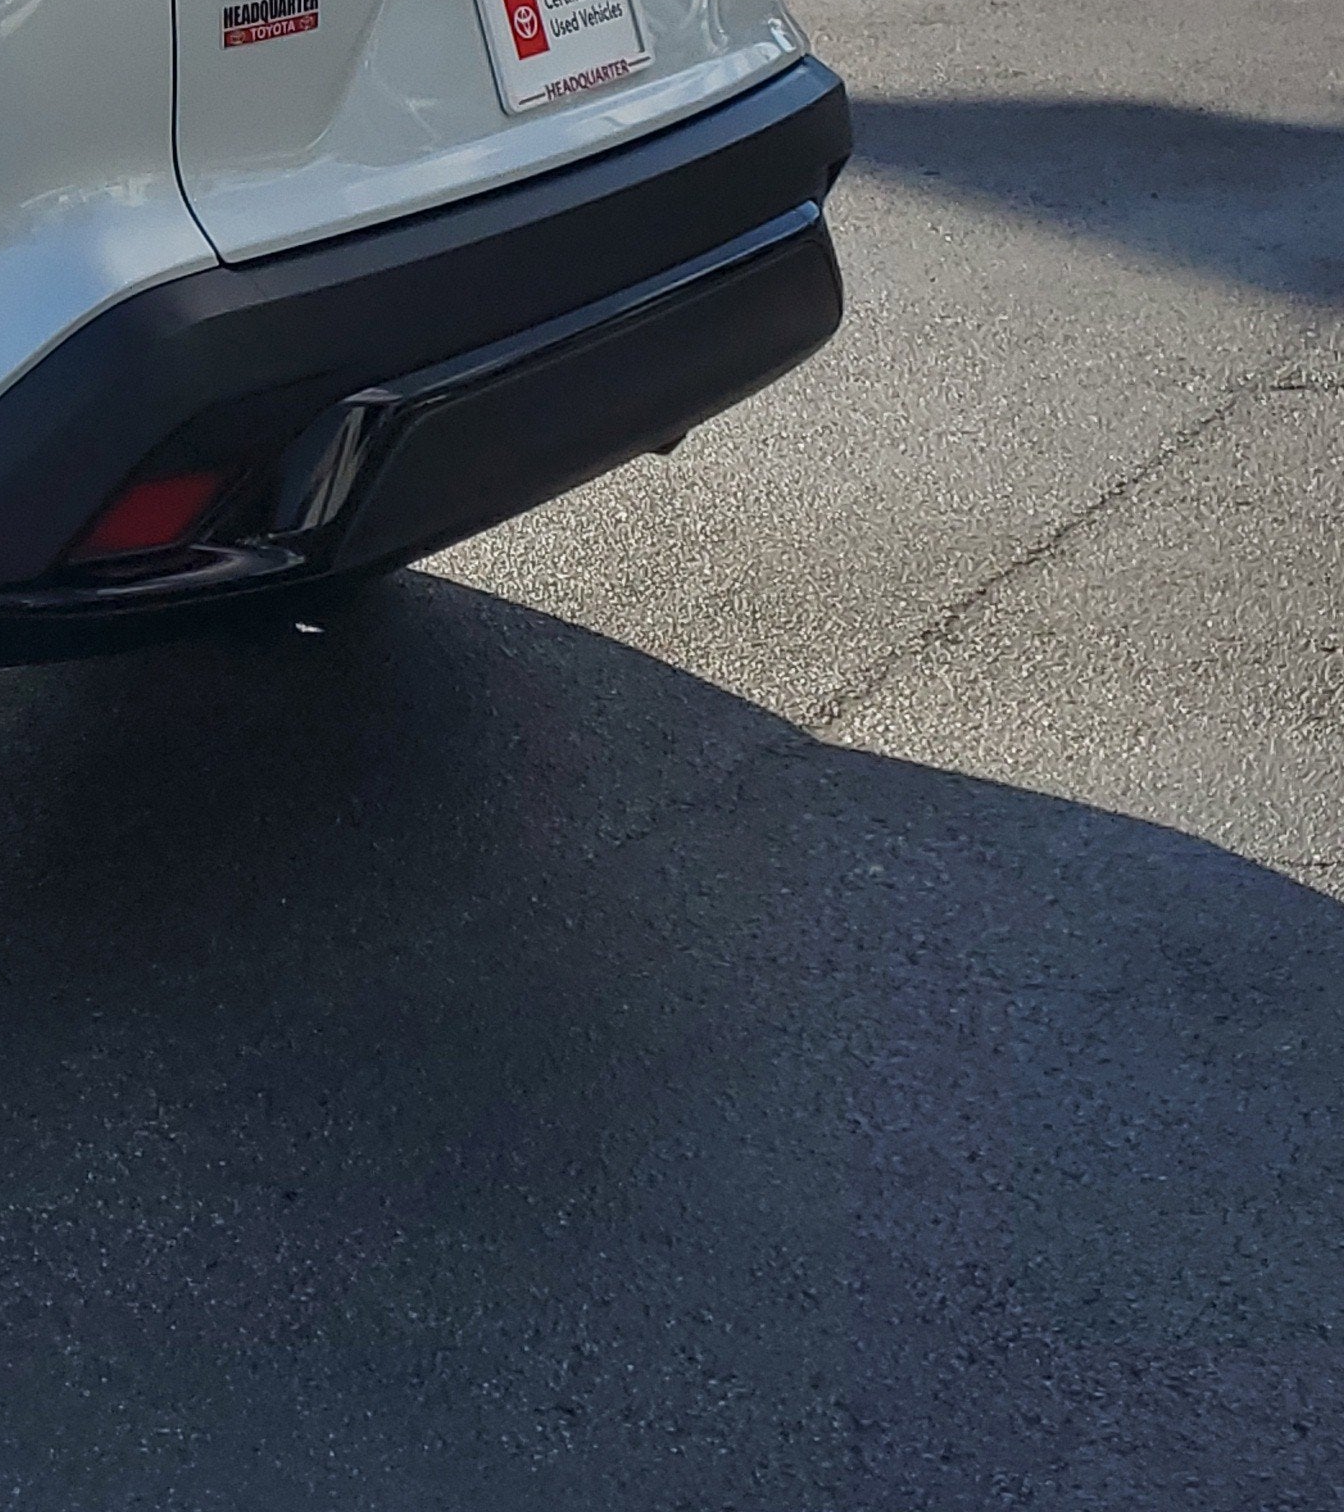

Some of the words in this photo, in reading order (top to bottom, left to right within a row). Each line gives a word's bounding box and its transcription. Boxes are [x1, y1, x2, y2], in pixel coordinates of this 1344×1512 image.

[250, 19, 296, 41] TOYOTA
[550, 13, 580, 38] Used
[579, 1, 623, 28] Vehicles
[545, 58, 631, 101] HEADQUARTER
